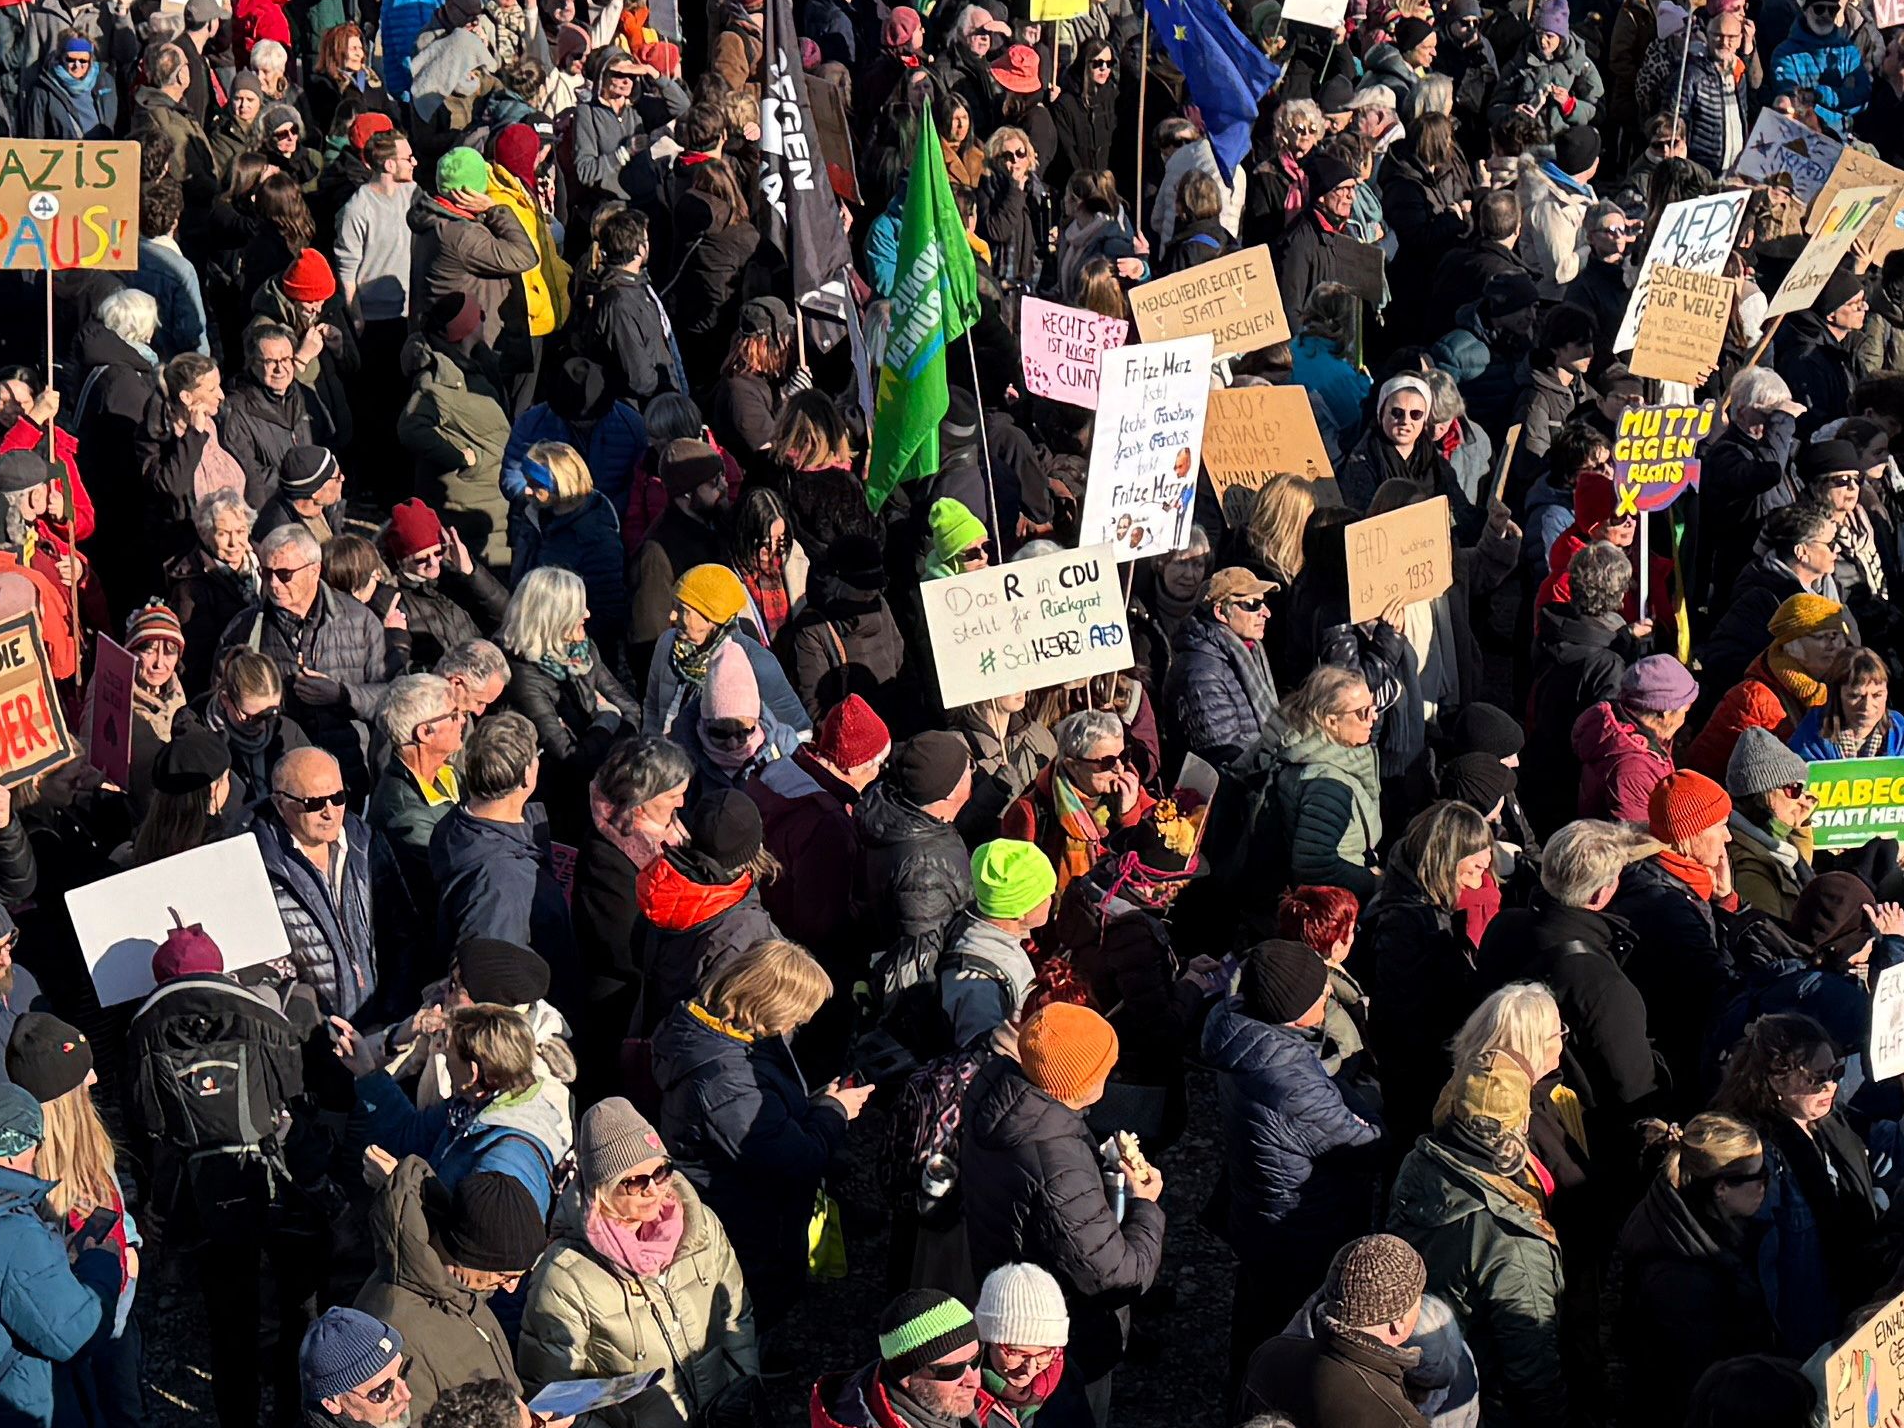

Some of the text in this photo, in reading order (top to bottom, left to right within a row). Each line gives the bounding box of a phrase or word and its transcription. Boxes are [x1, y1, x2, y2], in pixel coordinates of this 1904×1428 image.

[1135, 260, 1259, 315] MENSCHENRECHTE
[1648, 286, 1678, 309] FÜR
[1653, 266, 1737, 300] SICHERHEIT
[1041, 310, 1098, 343] RECHTS
[1182, 296, 1228, 326] STATT
[1213, 309, 1276, 347] ENSCHEN
[1047, 336, 1098, 364] IST NICHT
[1124, 355, 1193, 387] Fritze Merz
[1615, 436, 1696, 462] GEGEN
[1628, 460, 1684, 484] RECHTS
[945, 559, 1101, 614] Das R in CDU
[1360, 560, 1436, 605] ist so 1933
[951, 592, 1104, 646] steht für Rückgrat
[1811, 805, 1873, 829] STATT
